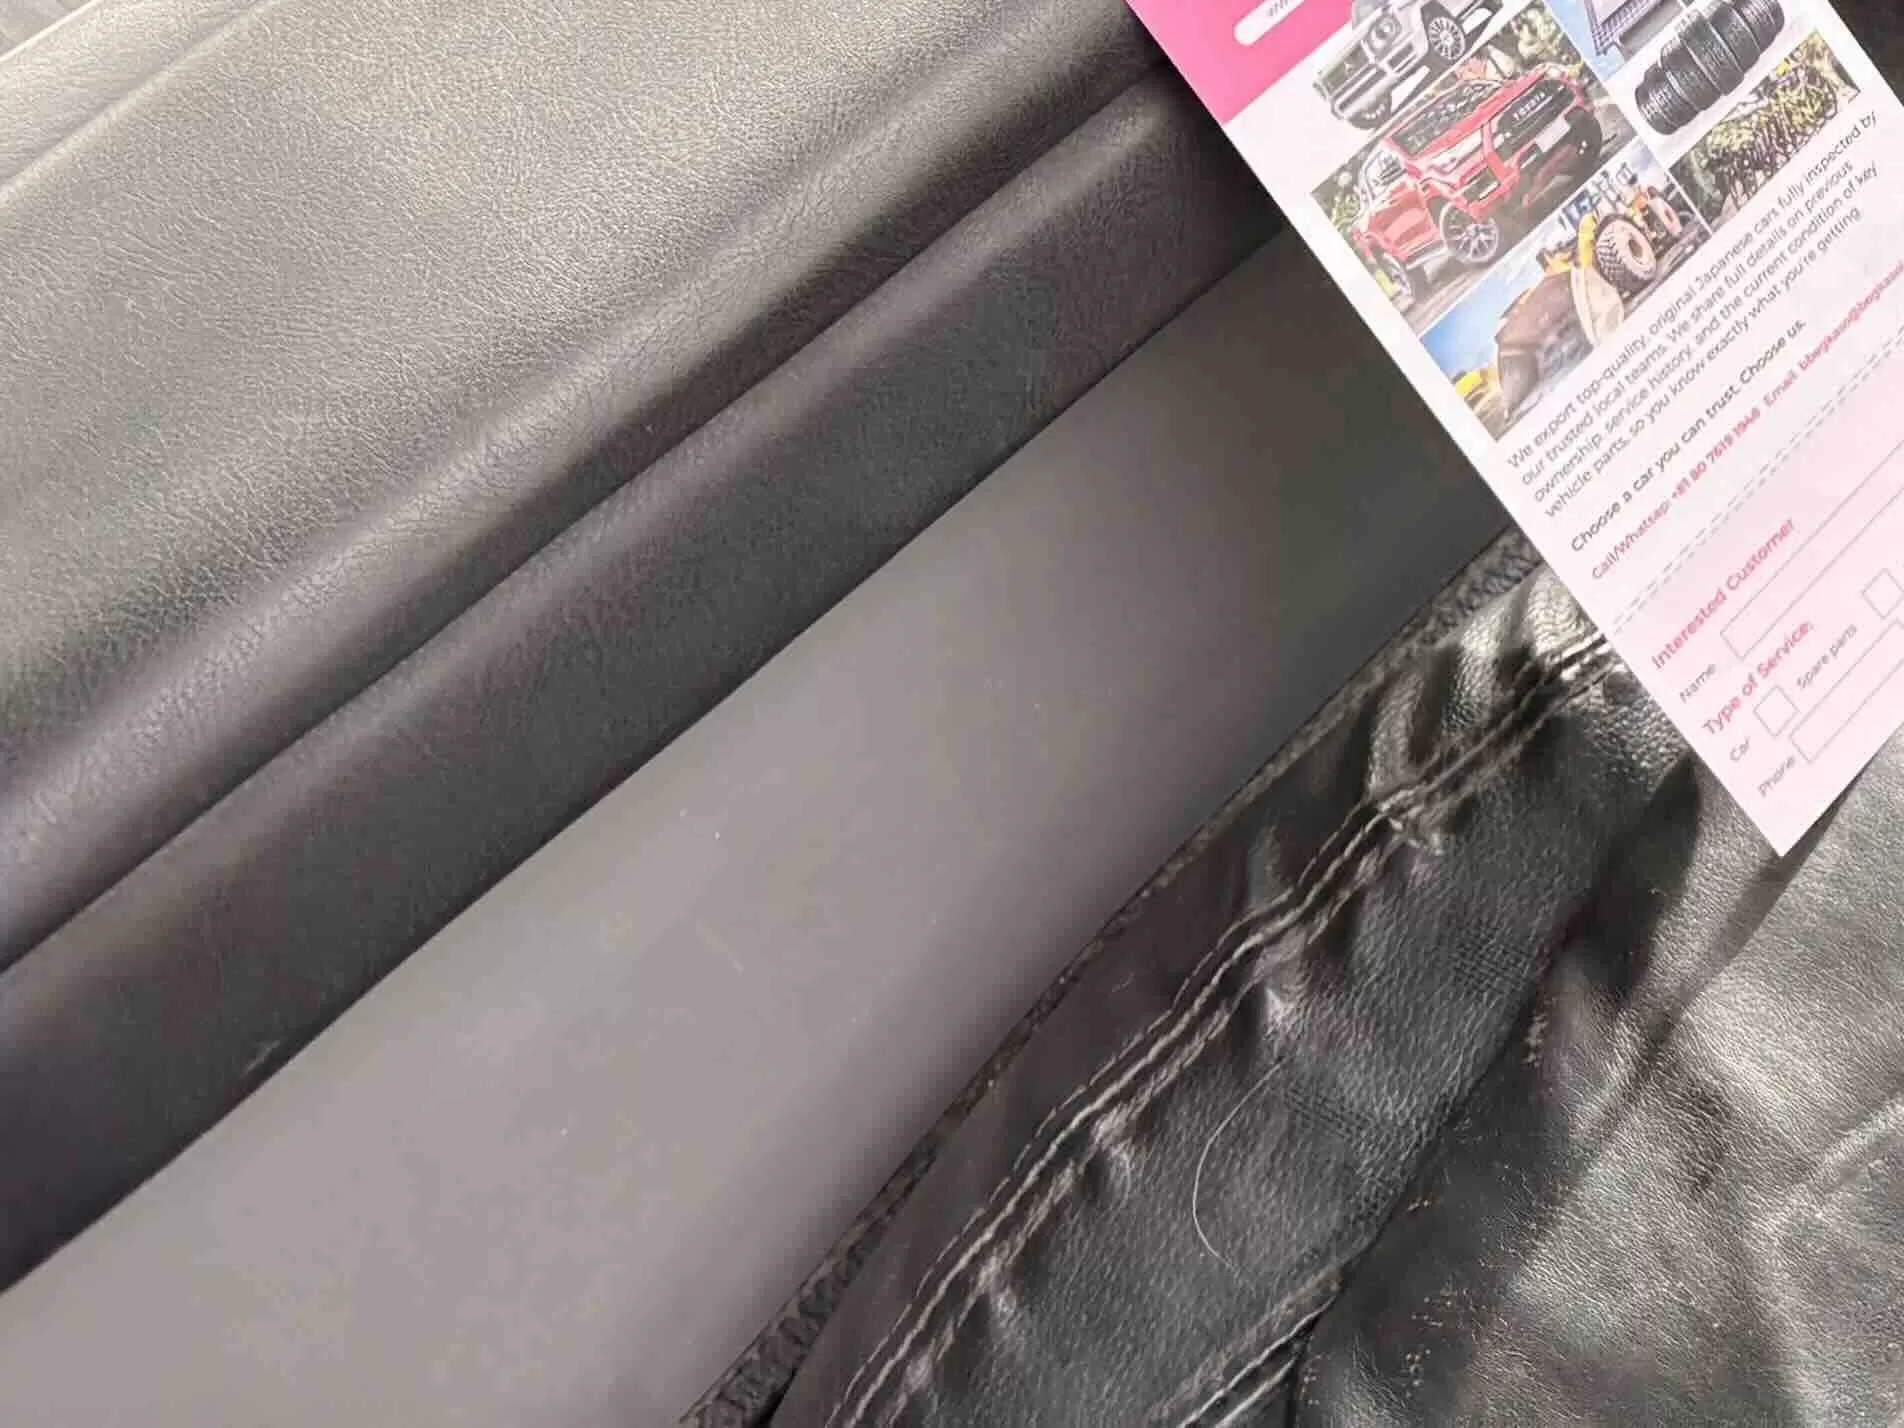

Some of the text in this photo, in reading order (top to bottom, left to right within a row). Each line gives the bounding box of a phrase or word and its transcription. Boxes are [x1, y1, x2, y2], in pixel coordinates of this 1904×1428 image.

[1506, 443, 1533, 468] We
[1533, 401, 1577, 447] export
[1648, 285, 1697, 335] original
[1694, 231, 1753, 291] Japanese
[1753, 207, 1780, 234] cars
[1776, 181, 1804, 209] fully
[1804, 123, 1861, 184] inspected
[1858, 110, 1876, 129] by
[1521, 458, 1545, 486] our
[1544, 410, 1594, 462] trusted
[1591, 379, 1625, 416] local
[1666, 319, 1690, 343] We
[1723, 262, 1746, 288] full
[1745, 225, 1787, 268] details
[1786, 208, 1804, 229] on
[1694, 315, 1720, 345] and
[1718, 295, 1742, 320] the
[1742, 250, 1788, 297] current
[1786, 197, 1843, 254] condition
[1842, 180, 1856, 199] of
[1544, 470, 1592, 517] vehicle
[1628, 418, 1645, 437] so
[1644, 393, 1670, 424] you
[1667, 358, 1705, 396] know
[1705, 315, 1749, 361] exactly
[1747, 283, 1781, 318] what
[1570, 501, 1621, 552] Choose
[1621, 490, 1632, 503] a
[1632, 466, 1654, 492] car
[1654, 441, 1681, 472] you
[1680, 417, 1706, 443] can
[1738, 336, 1786, 384] Choose
[1651, 518, 1793, 669] Interested Customer
[1702, 695, 1741, 734] Type
[1741, 672, 1758, 697] of
